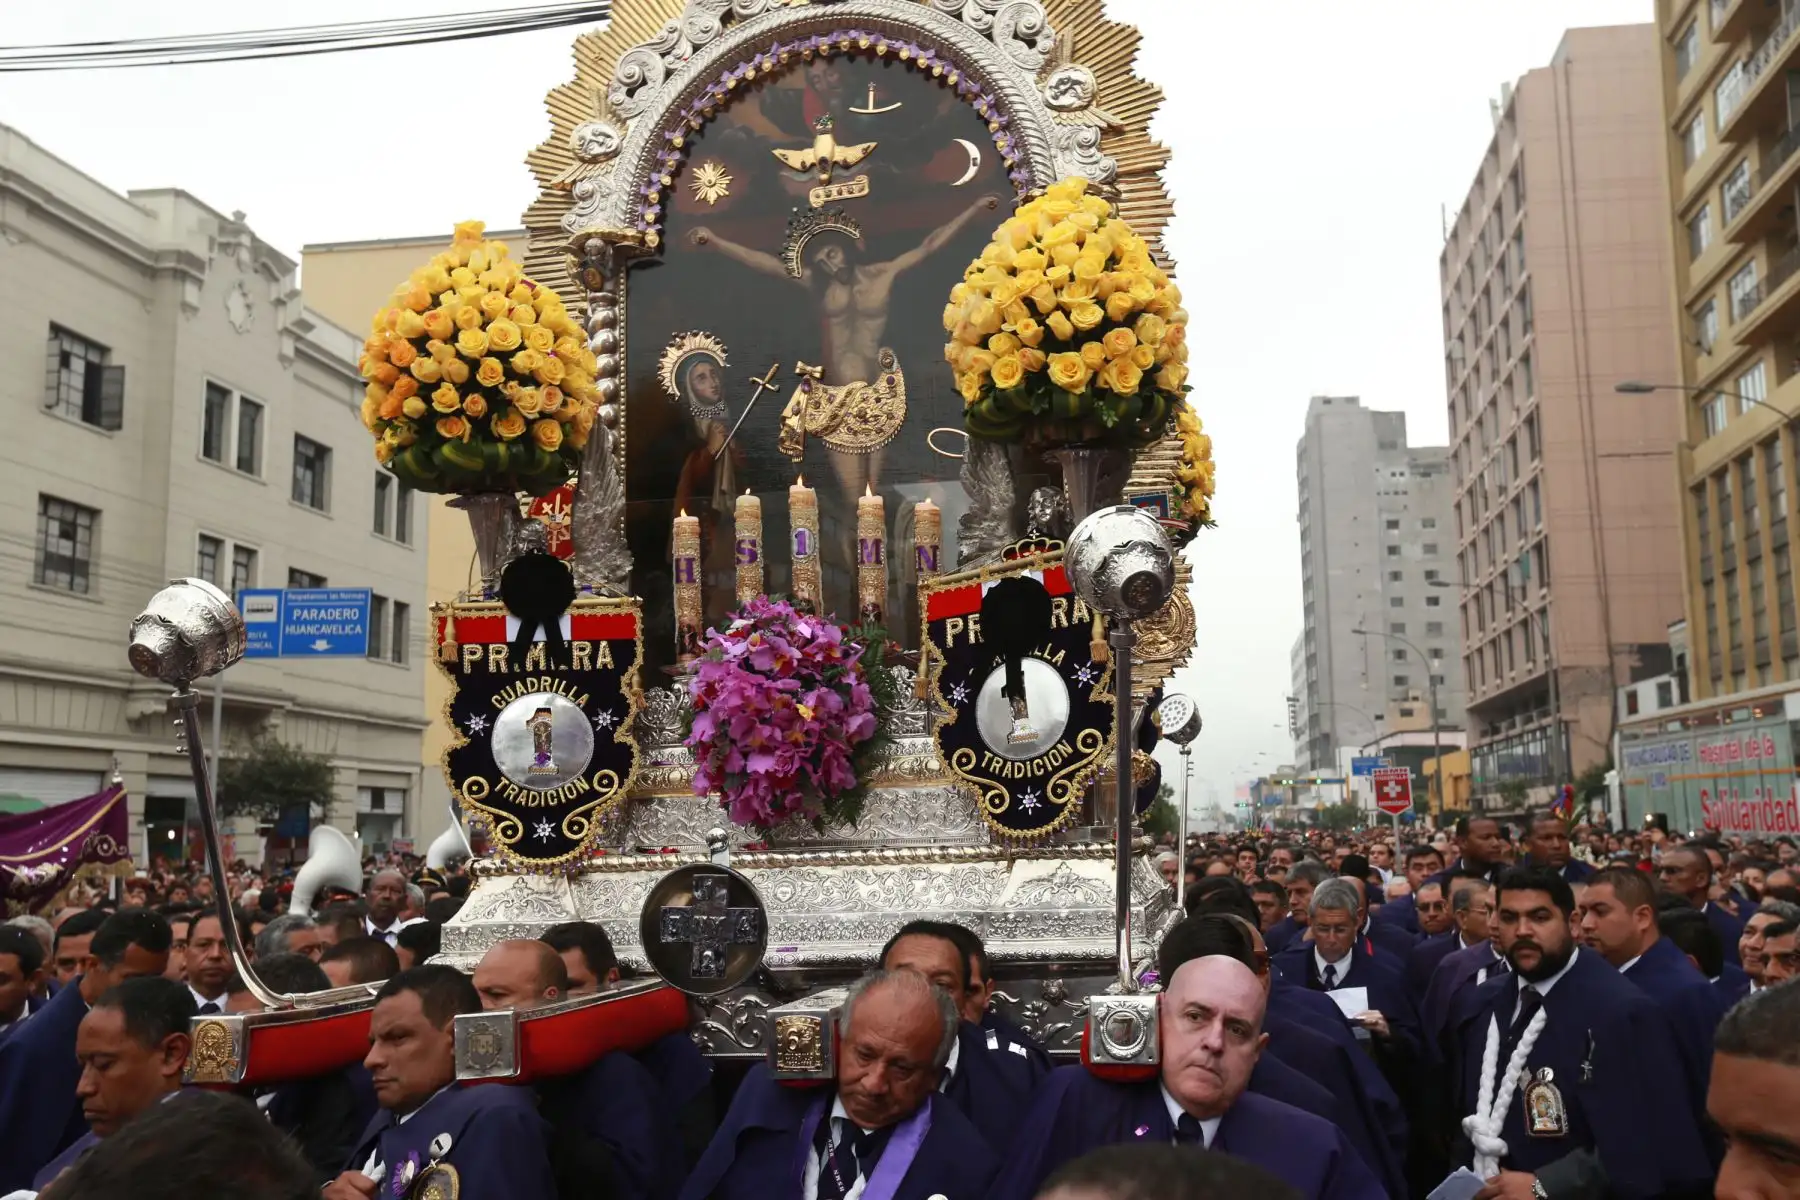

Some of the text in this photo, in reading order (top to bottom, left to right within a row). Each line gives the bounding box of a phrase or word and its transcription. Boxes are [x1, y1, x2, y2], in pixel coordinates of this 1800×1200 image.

[675, 556, 696, 584] H
[735, 539, 757, 565] S
[859, 538, 882, 565] M
[916, 545, 939, 572] N
[285, 624, 362, 635] HUANCAVELICA
[293, 608, 359, 620] PARADERO
[462, 640, 615, 674] PRMRA
[491, 676, 591, 709] CUADRILLA
[980, 740, 1074, 779] TRADICION
[1699, 731, 1775, 768] Hospital de la
[494, 777, 590, 808] TRADICION
[1700, 785, 1800, 833] Solidaridad
[434, 1138, 444, 1152] 1
